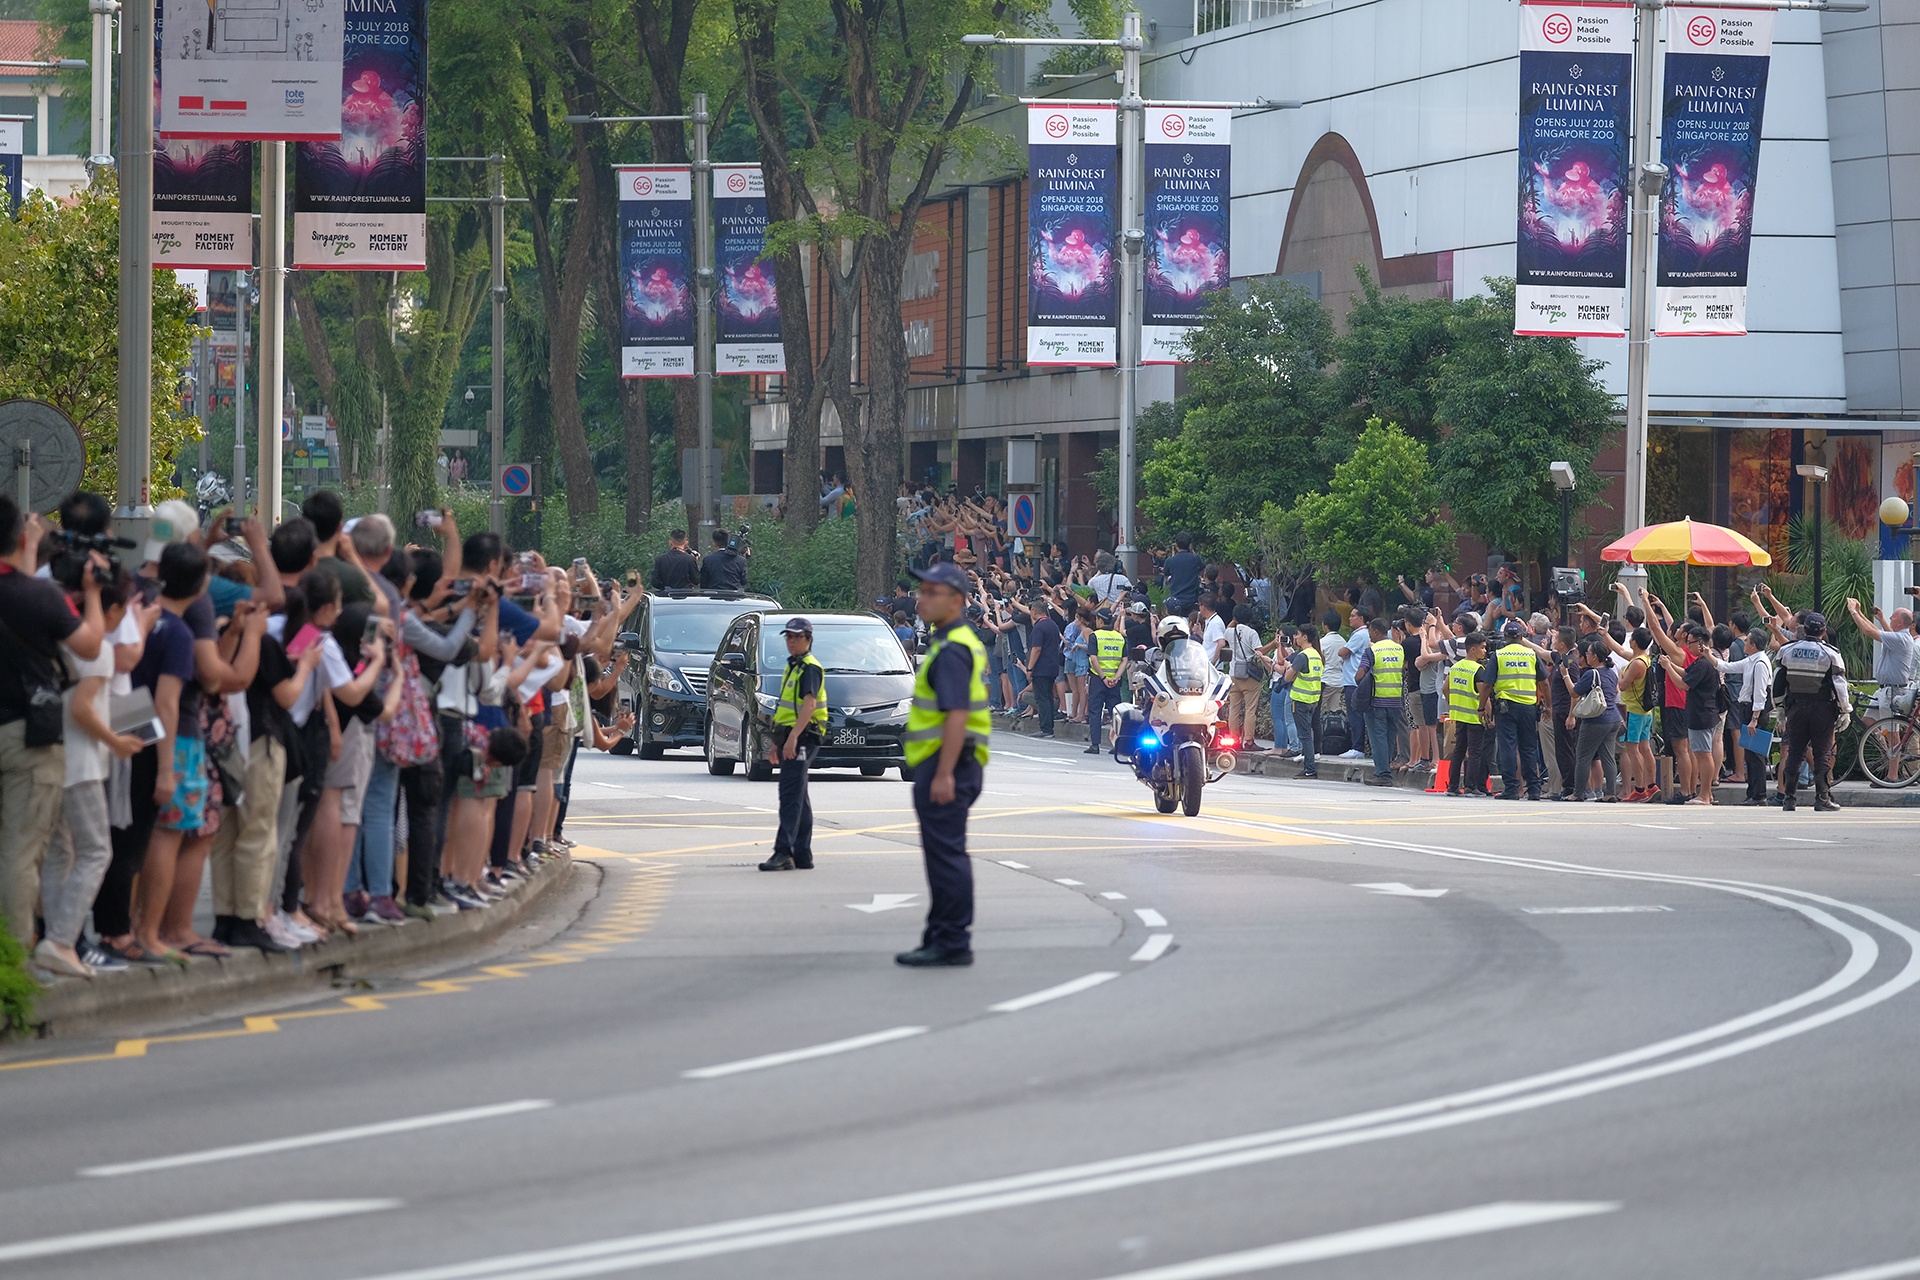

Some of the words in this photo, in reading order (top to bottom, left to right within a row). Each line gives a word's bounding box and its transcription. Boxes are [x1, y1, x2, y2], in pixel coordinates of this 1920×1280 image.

[1577, 16, 1609, 24] Passion
[1721, 19, 1753, 27] Passion
[356, 22, 381, 32] JULY
[384, 22, 409, 33] 2018
[1547, 22, 1569, 35] SG
[1577, 26, 1600, 34] Made
[1691, 24, 1712, 37] SG
[343, 34, 380, 45] APORE
[383, 35, 409, 45] ZOO
[1577, 36, 1611, 44] Possible
[1720, 38, 1754, 46] Possible
[285, 89, 304, 98] tote
[1532, 82, 1618, 97] RAINFOREST
[1675, 84, 1757, 99] RAINFOREST
[1546, 98, 1604, 112] LUMINA
[1688, 101, 1744, 114] LUMINA
[1049, 121, 1066, 132] SG
[1165, 121, 1182, 131] SG
[1535, 118, 1567, 127] OPENS
[1568, 118, 1591, 128] JULY
[1593, 119, 1615, 128] 2018
[1677, 119, 1707, 129] OPENS
[1708, 120, 1731, 130] JULY
[1733, 121, 1750, 131] 2018
[1535, 129, 1590, 139] SINGAPORE
[1592, 130, 1614, 139] ZOO
[1676, 131, 1729, 141] SINGAPORE
[1731, 132, 1749, 141] ZOO
[1038, 168, 1106, 179] RAINFOREST
[1154, 167, 1221, 178] RAINFOREST
[636, 181, 650, 190] SG
[730, 179, 744, 187] SG
[1049, 181, 1095, 191] LUMINA
[1165, 180, 1211, 190] LUMINA
[310, 195, 411, 203] WWW.RAINFORESTLUMINA.SG
[1086, 196, 1104, 204] 2018
[1156, 195, 1182, 203] OPENS
[1183, 195, 1200, 203] JULY
[1201, 195, 1219, 203] 2018
[1041, 204, 1084, 212] SINGAPORE
[1156, 203, 1199, 211] SINGAPORE
[1201, 204, 1219, 212] ZOO
[628, 219, 683, 228] RAINFOREST
[195, 233, 235, 242] MOMENT
[637, 229, 675, 237] LUMINA
[311, 230, 350, 247] Singapore
[369, 234, 408, 242] MOMENT
[195, 242, 235, 251] FACTORY
[369, 243, 408, 251] FACTORY
[1528, 270, 1614, 278] WWW.RAINFORESTLUMINA.SG
[1530, 301, 1562, 316] Singapore
[1578, 305, 1610, 313] MOMENT
[1666, 302, 1692, 317] Singapore
[1706, 304, 1734, 312] MOMENT
[1577, 312, 1611, 320] FACTORY
[1039, 338, 1065, 350] Singapore
[141, 487, 147, 503] 5
[1792, 649, 1819, 659] POLICE
[840, 728, 859, 737] SKJ
[833, 736, 866, 745] 2820D
